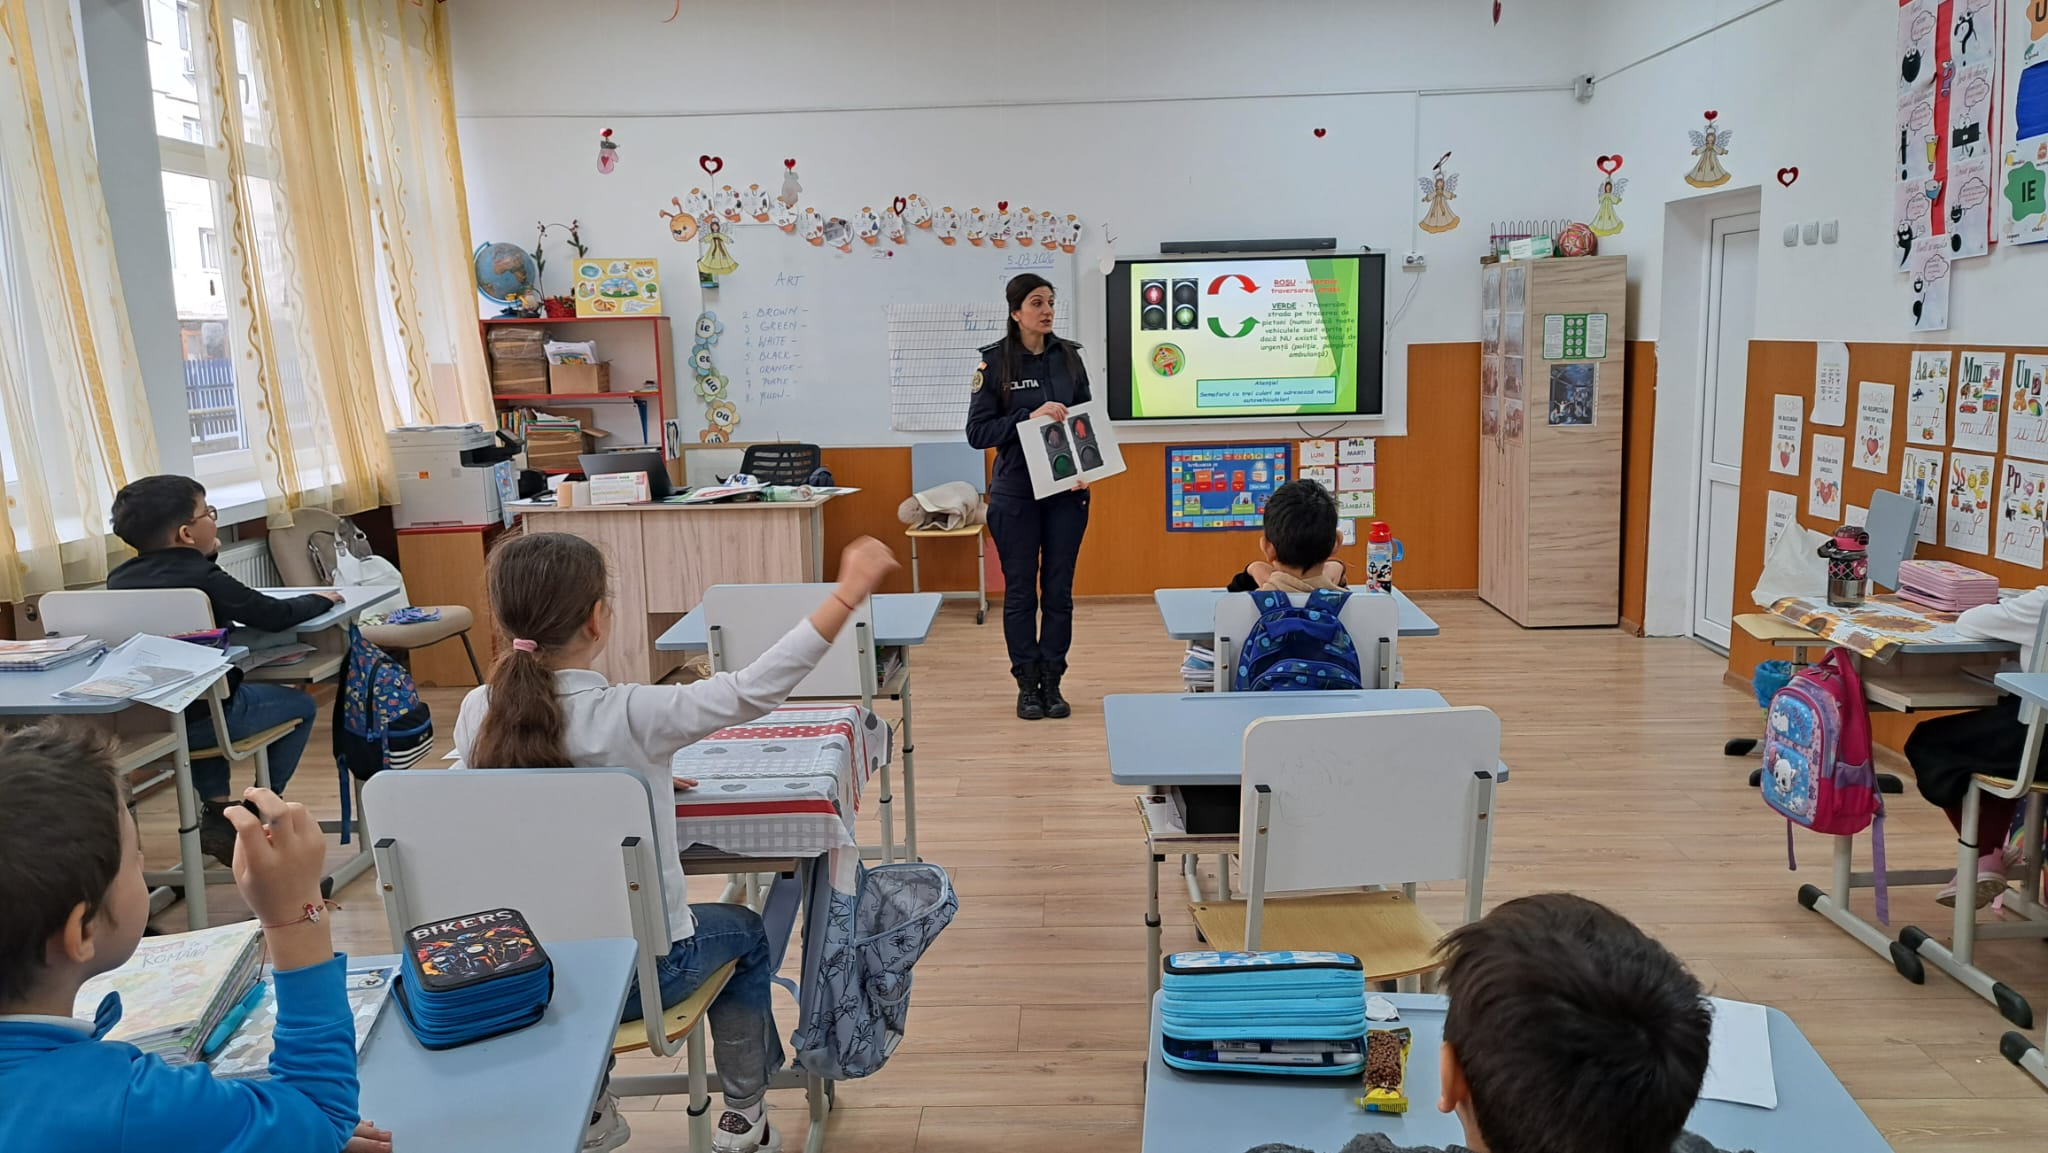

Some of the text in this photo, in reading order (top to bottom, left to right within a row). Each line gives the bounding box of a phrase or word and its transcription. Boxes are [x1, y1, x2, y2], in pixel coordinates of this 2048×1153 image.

[2022, 180, 2036, 203] IE
[774, 272, 805, 287] ART
[756, 306, 799, 318] BROWN
[1271, 302, 1296, 310] VERDE
[700, 321, 711, 332] ie
[760, 320, 798, 332] GREEN
[758, 336, 786, 348] WHITE
[759, 351, 791, 361] BLACK
[1962, 356, 1983, 383] Mm
[2016, 360, 2031, 388] Uu
[705, 378, 718, 393] ua
[715, 411, 730, 422] oa
[1960, 413, 1994, 436] m M
[2014, 428, 2029, 440] u
[1353, 466, 1360, 474] J
[1951, 458, 1966, 487] Ss
[2007, 465, 2021, 495] Pp
[1352, 493, 1360, 501] S
[2002, 526, 2041, 554] p P
[412, 910, 514, 941] BIKERS
